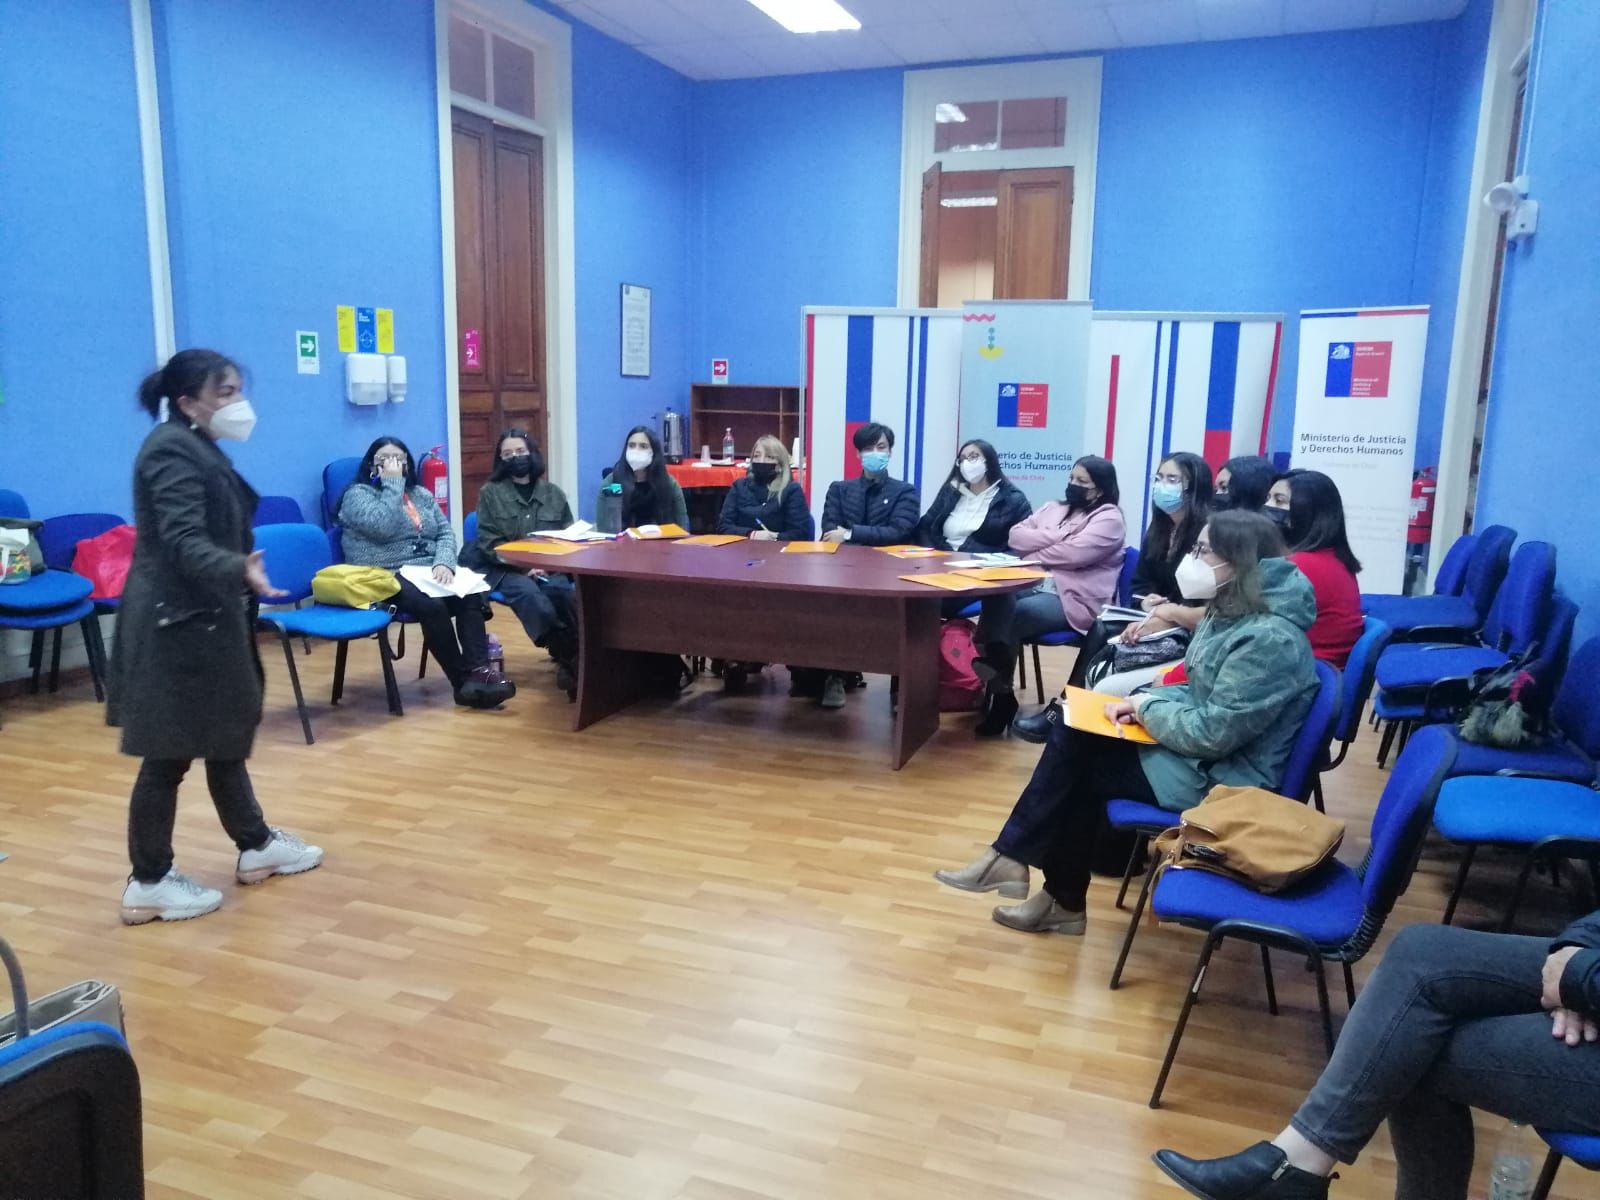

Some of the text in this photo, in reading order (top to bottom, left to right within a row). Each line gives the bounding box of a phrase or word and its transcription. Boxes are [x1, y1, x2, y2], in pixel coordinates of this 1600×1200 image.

[1300, 433, 1407, 445] Ministerio de Justicia
[1300, 444, 1404, 456] y Derechos Humanos
[1019, 452, 1032, 460] de
[1034, 452, 1072, 461] Justicia
[1024, 462, 1072, 471] Humanos
